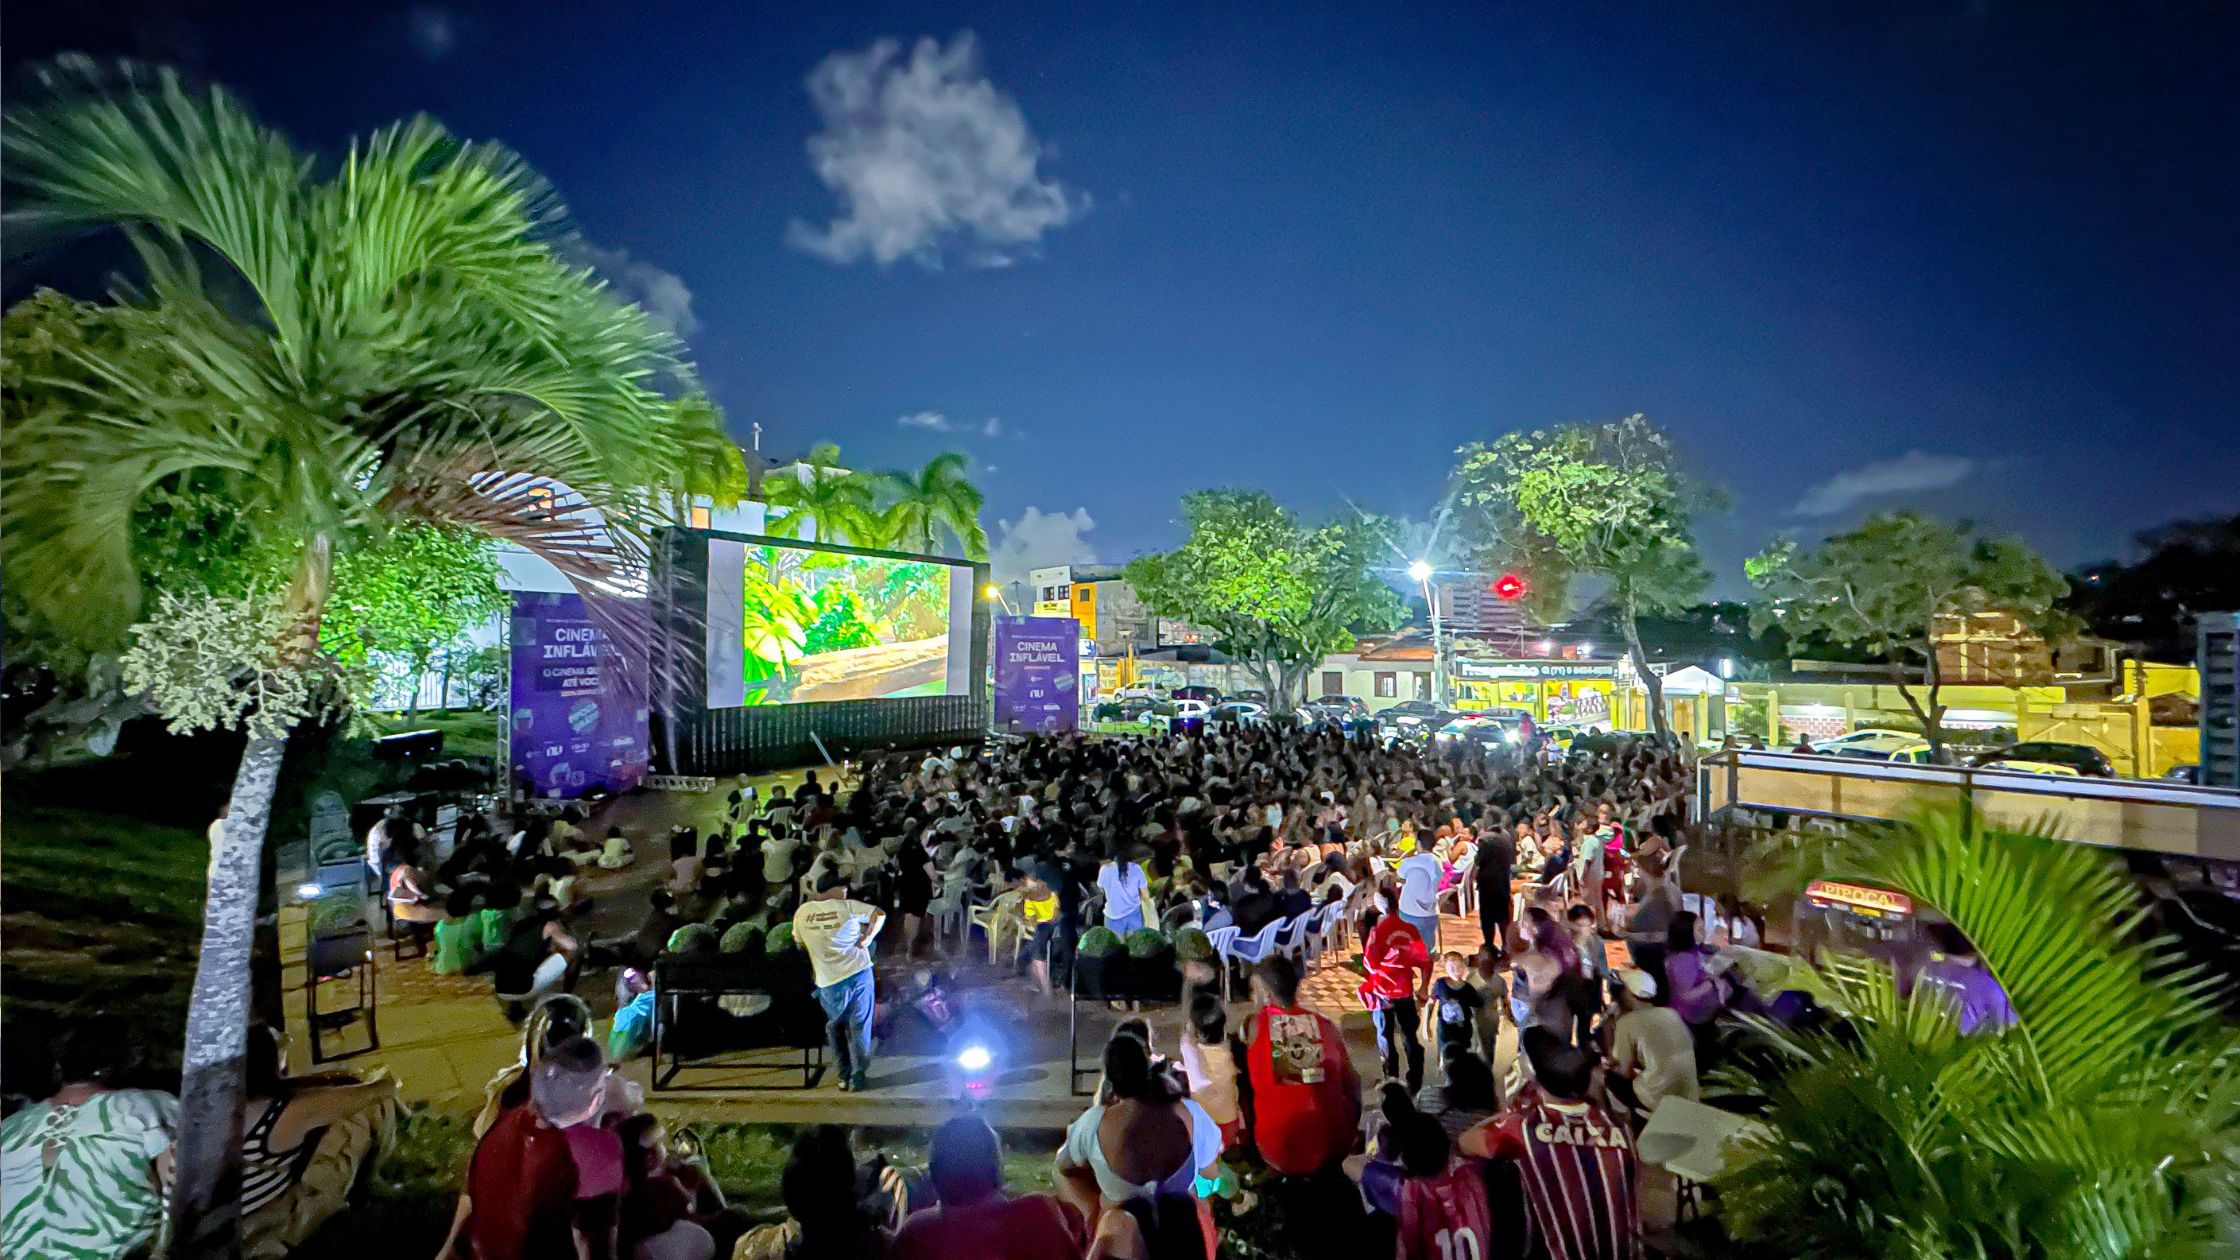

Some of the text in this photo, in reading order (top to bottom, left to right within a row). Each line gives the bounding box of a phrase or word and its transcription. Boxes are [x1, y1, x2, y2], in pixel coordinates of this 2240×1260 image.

[555, 627, 606, 642] CINEM
[543, 642, 621, 658] INFLÁVL
[1017, 641, 1058, 652] CINEMA
[1009, 650, 1066, 663] INFLÁVEL
[543, 668, 551, 677] O
[579, 677, 600, 686] VOC
[1824, 884, 1891, 906] PIPOCA
[1535, 1122, 1628, 1149] CAIXA
